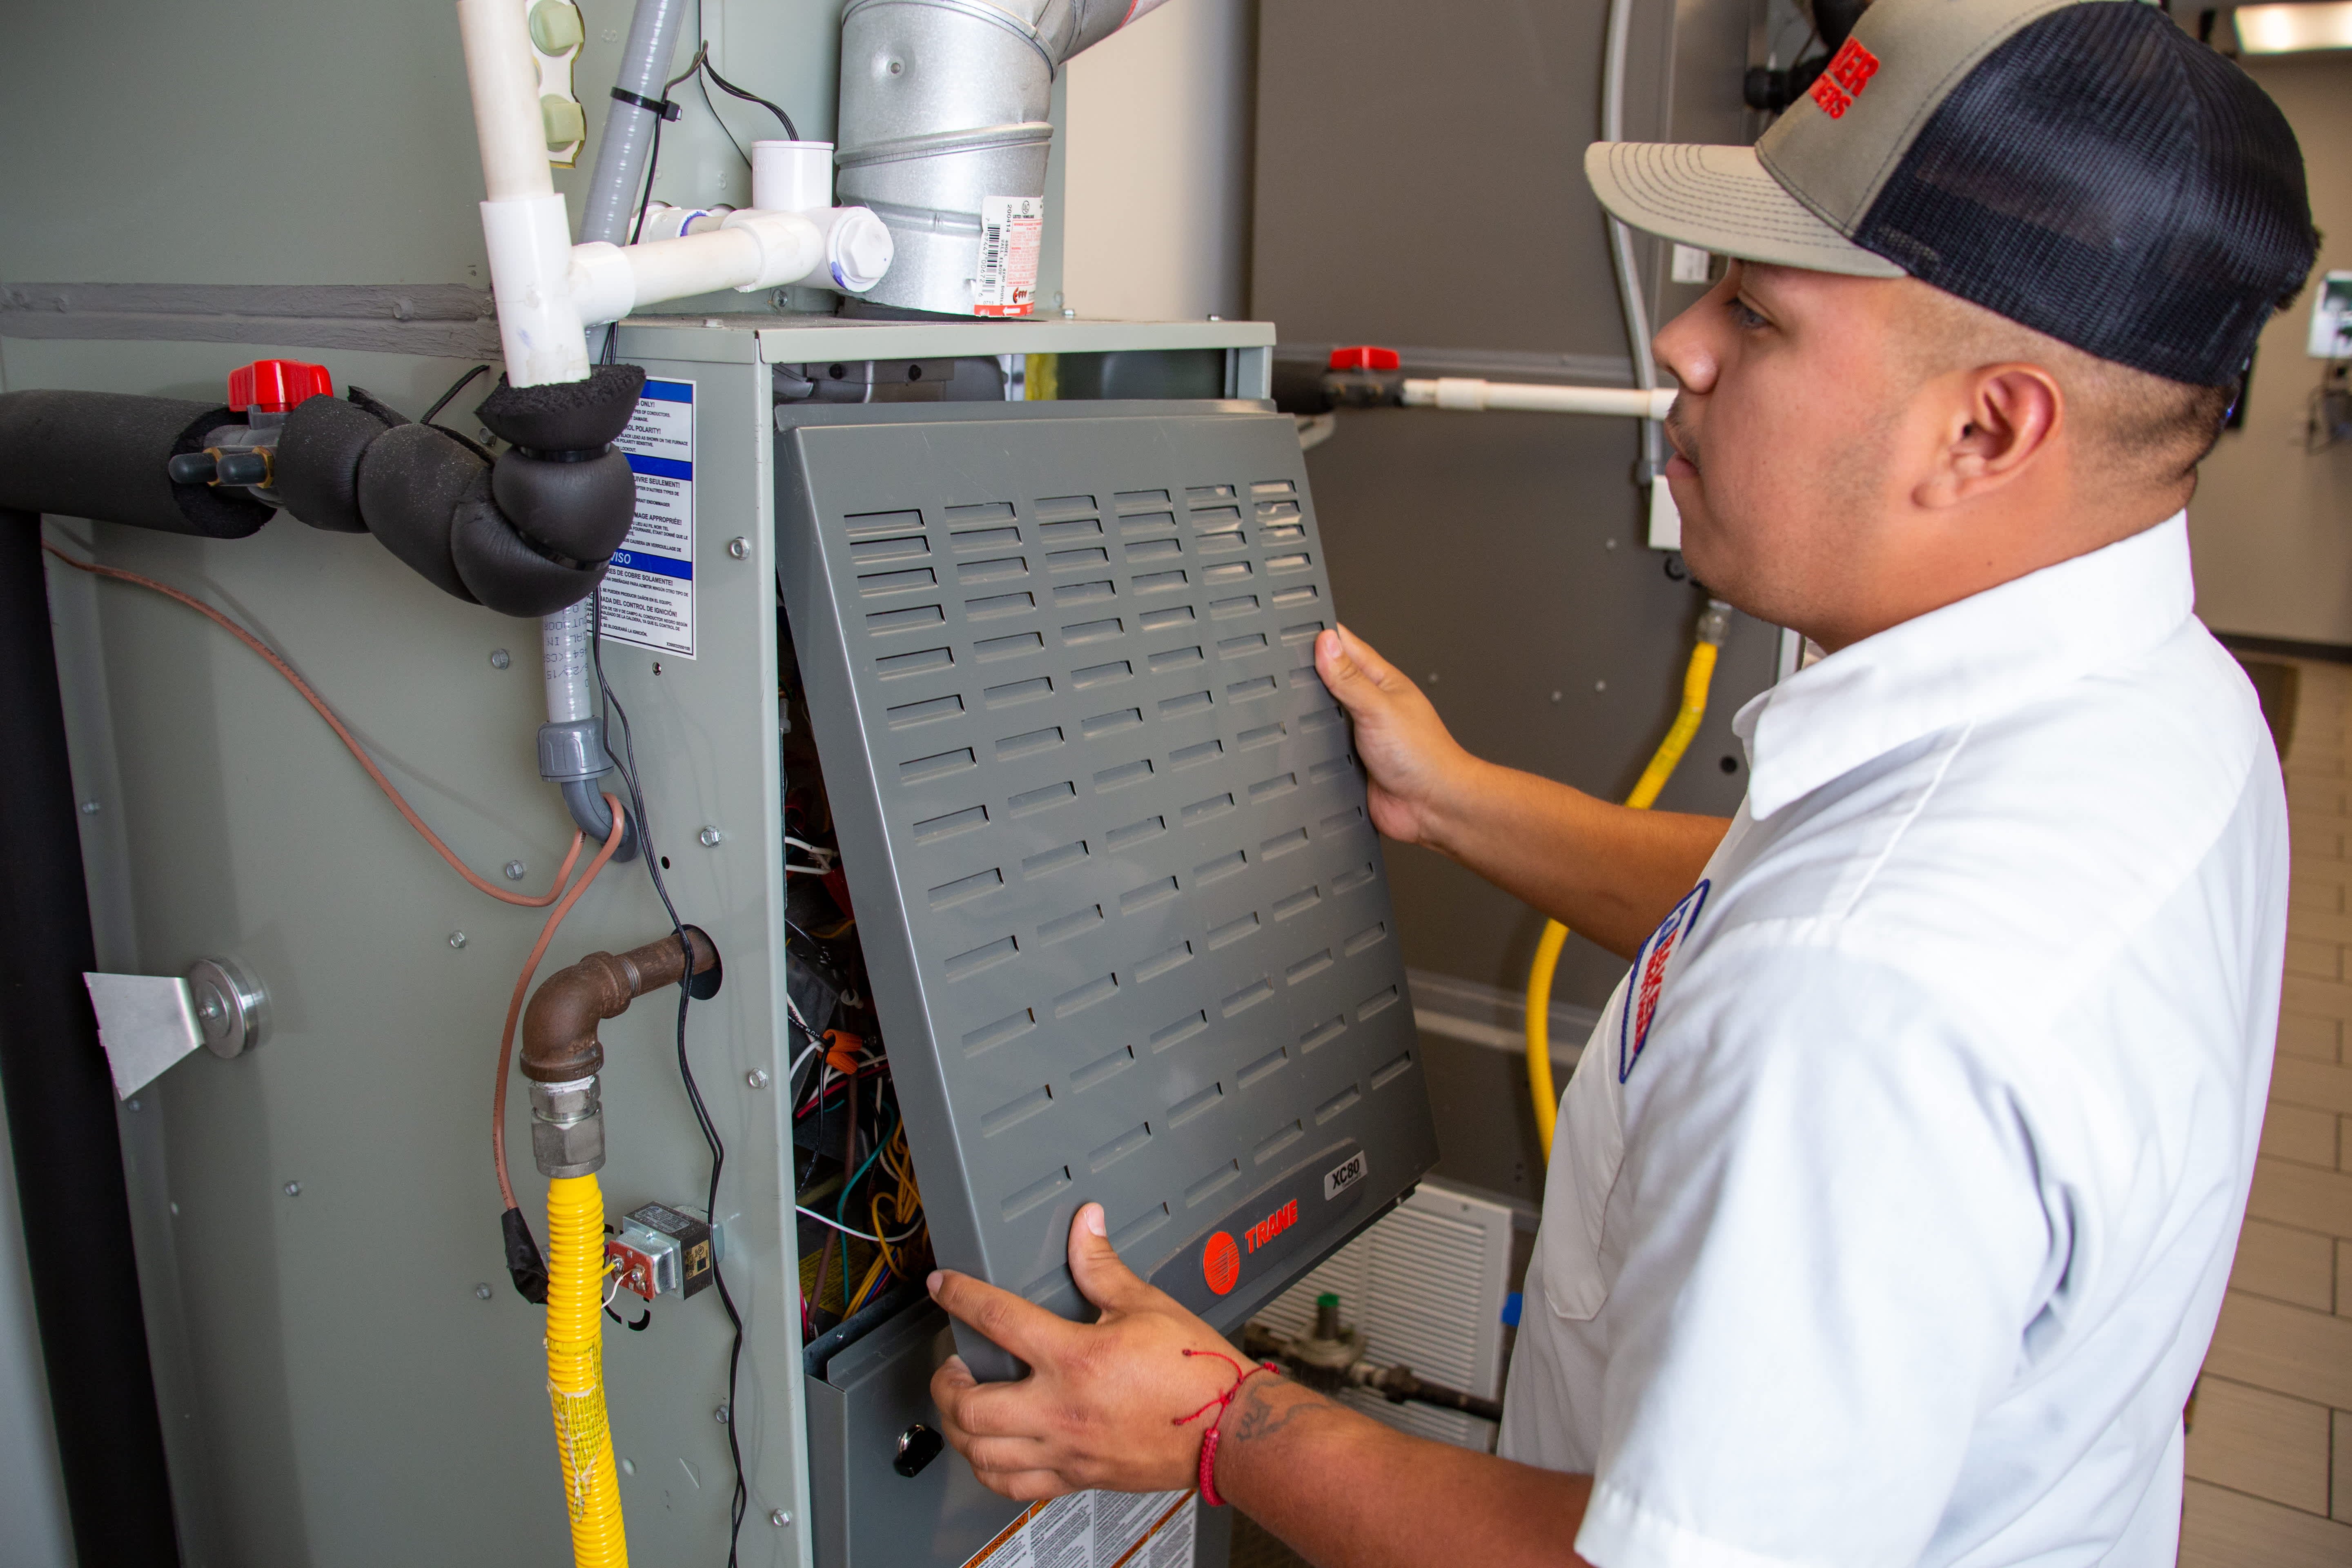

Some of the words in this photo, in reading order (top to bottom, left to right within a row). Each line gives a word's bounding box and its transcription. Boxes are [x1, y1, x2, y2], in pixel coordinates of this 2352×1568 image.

[636, 425, 661, 434] POLARITY!
[649, 478, 680, 488] SEULEMENT!
[649, 514, 682, 526] APPROPRIÉE!
[651, 543, 676, 551] VERROUILLAGE
[611, 552, 631, 564] VISO
[624, 571, 641, 579] COBRE
[642, 575, 673, 586] SOLAMENTE!
[623, 601, 646, 611] CONTROL
[654, 607, 677, 618] IGNICIÓN!
[1332, 1158, 1360, 1190] XC80
[1245, 1198, 1298, 1254] TRANE
[970, 1516, 1026, 1568] AVERTISSEMENT
